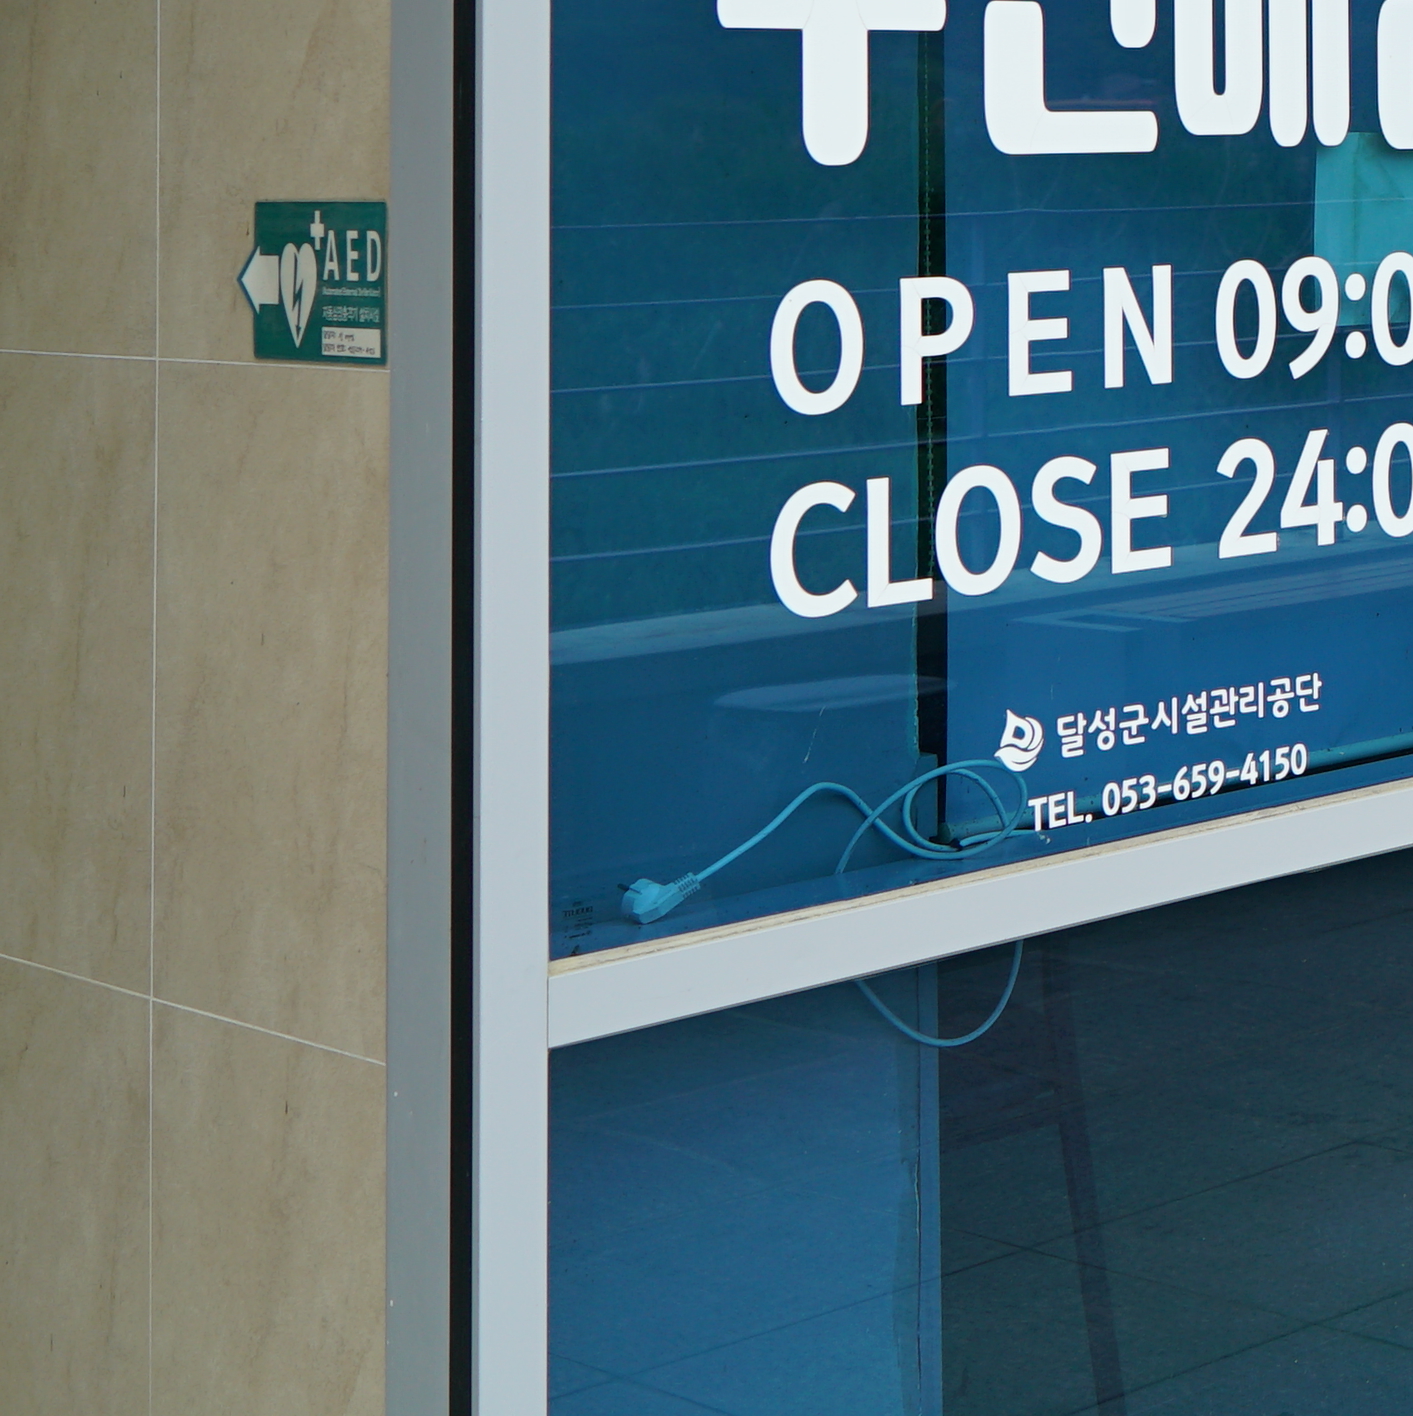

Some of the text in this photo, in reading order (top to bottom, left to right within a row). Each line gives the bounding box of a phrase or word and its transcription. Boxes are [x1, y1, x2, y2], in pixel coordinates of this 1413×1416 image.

[322, 229, 382, 282] AED
[770, 264, 1172, 415] OPEN
[770, 447, 1172, 618] CLOSE
[1057, 672, 1323, 758] 달성군시설관리공단
[1027, 743, 1308, 832] TEL. 053-659-4150
